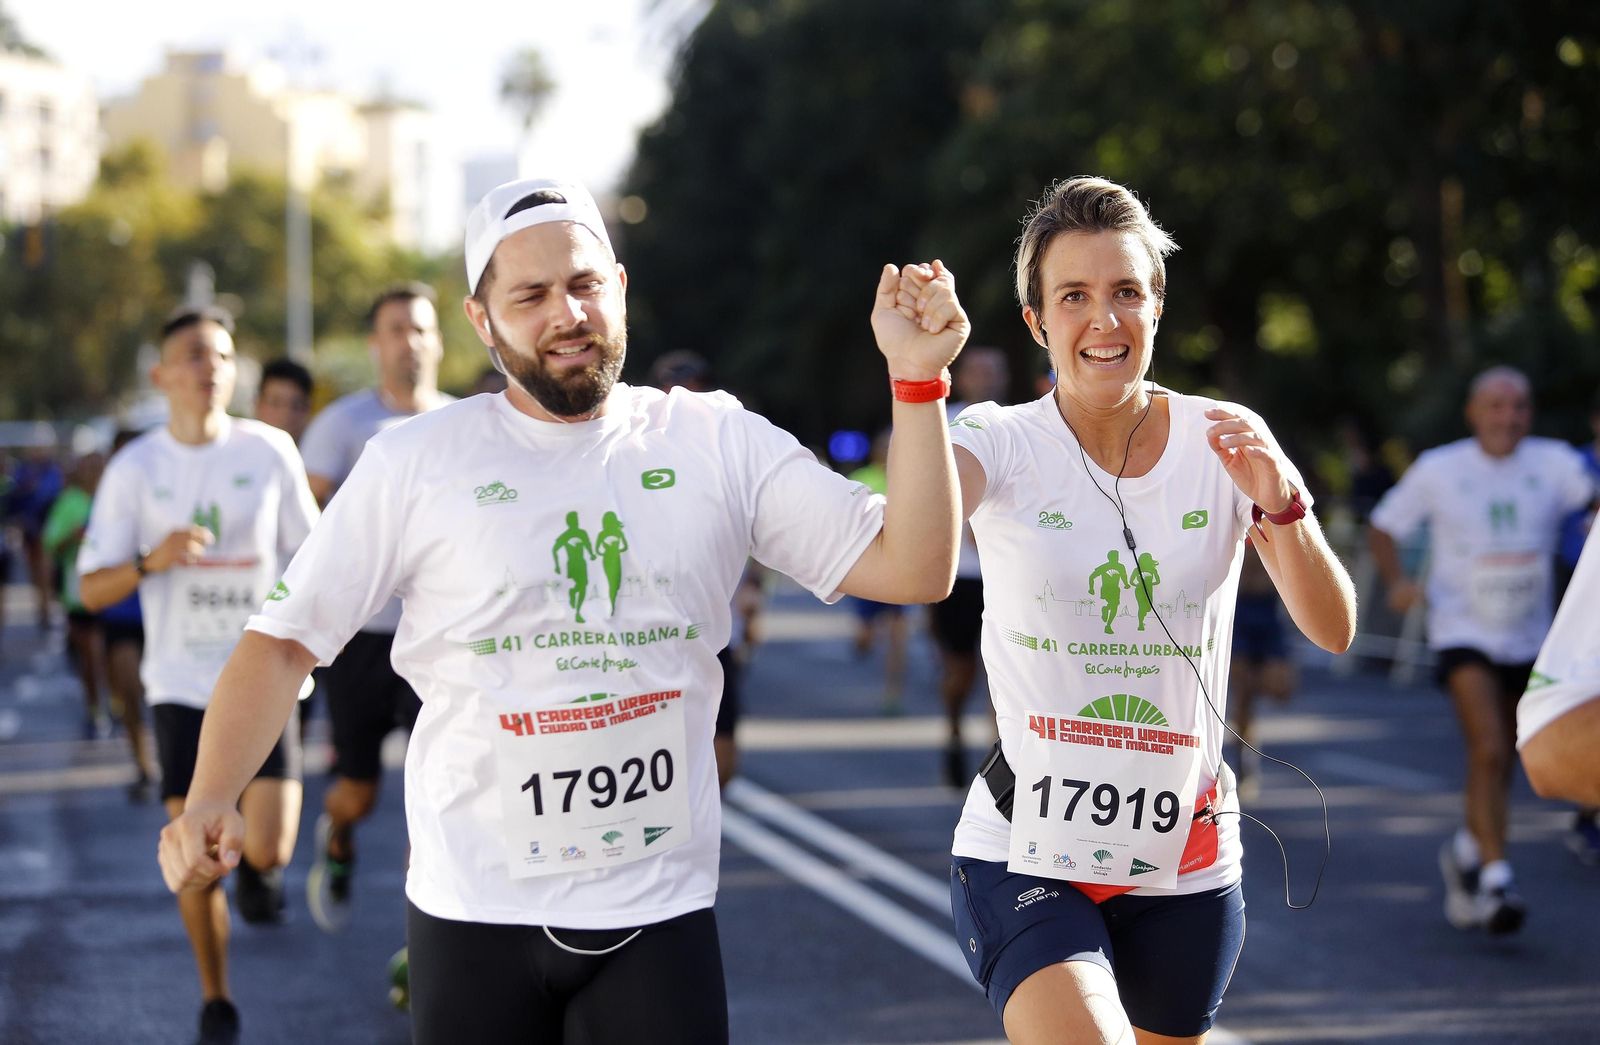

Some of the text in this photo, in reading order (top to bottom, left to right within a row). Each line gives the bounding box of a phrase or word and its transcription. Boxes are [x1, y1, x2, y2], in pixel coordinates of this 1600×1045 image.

[474, 485, 518, 499] 2020
[1039, 511, 1073, 528] 2020
[502, 636, 521, 651] 41
[534, 631, 618, 648] CARRERA
[1041, 638, 1202, 658] 41 CARRERA URBANA
[556, 657, 569, 671] El
[570, 656, 600, 670] Corte
[1085, 660, 1160, 678] El Corte Inglés
[499, 690, 681, 736] 41 CARRERA URBANA
[540, 722, 588, 734] CIUDAD
[591, 718, 606, 730] DE
[1029, 715, 1200, 748] 41 CARRERA URBANA
[1060, 732, 1104, 747] CIUDAD
[1107, 738, 1122, 749] DE
[521, 748, 674, 816] 17920
[1032, 775, 1180, 834] 17919
[1053, 853, 1077, 869] 2020
